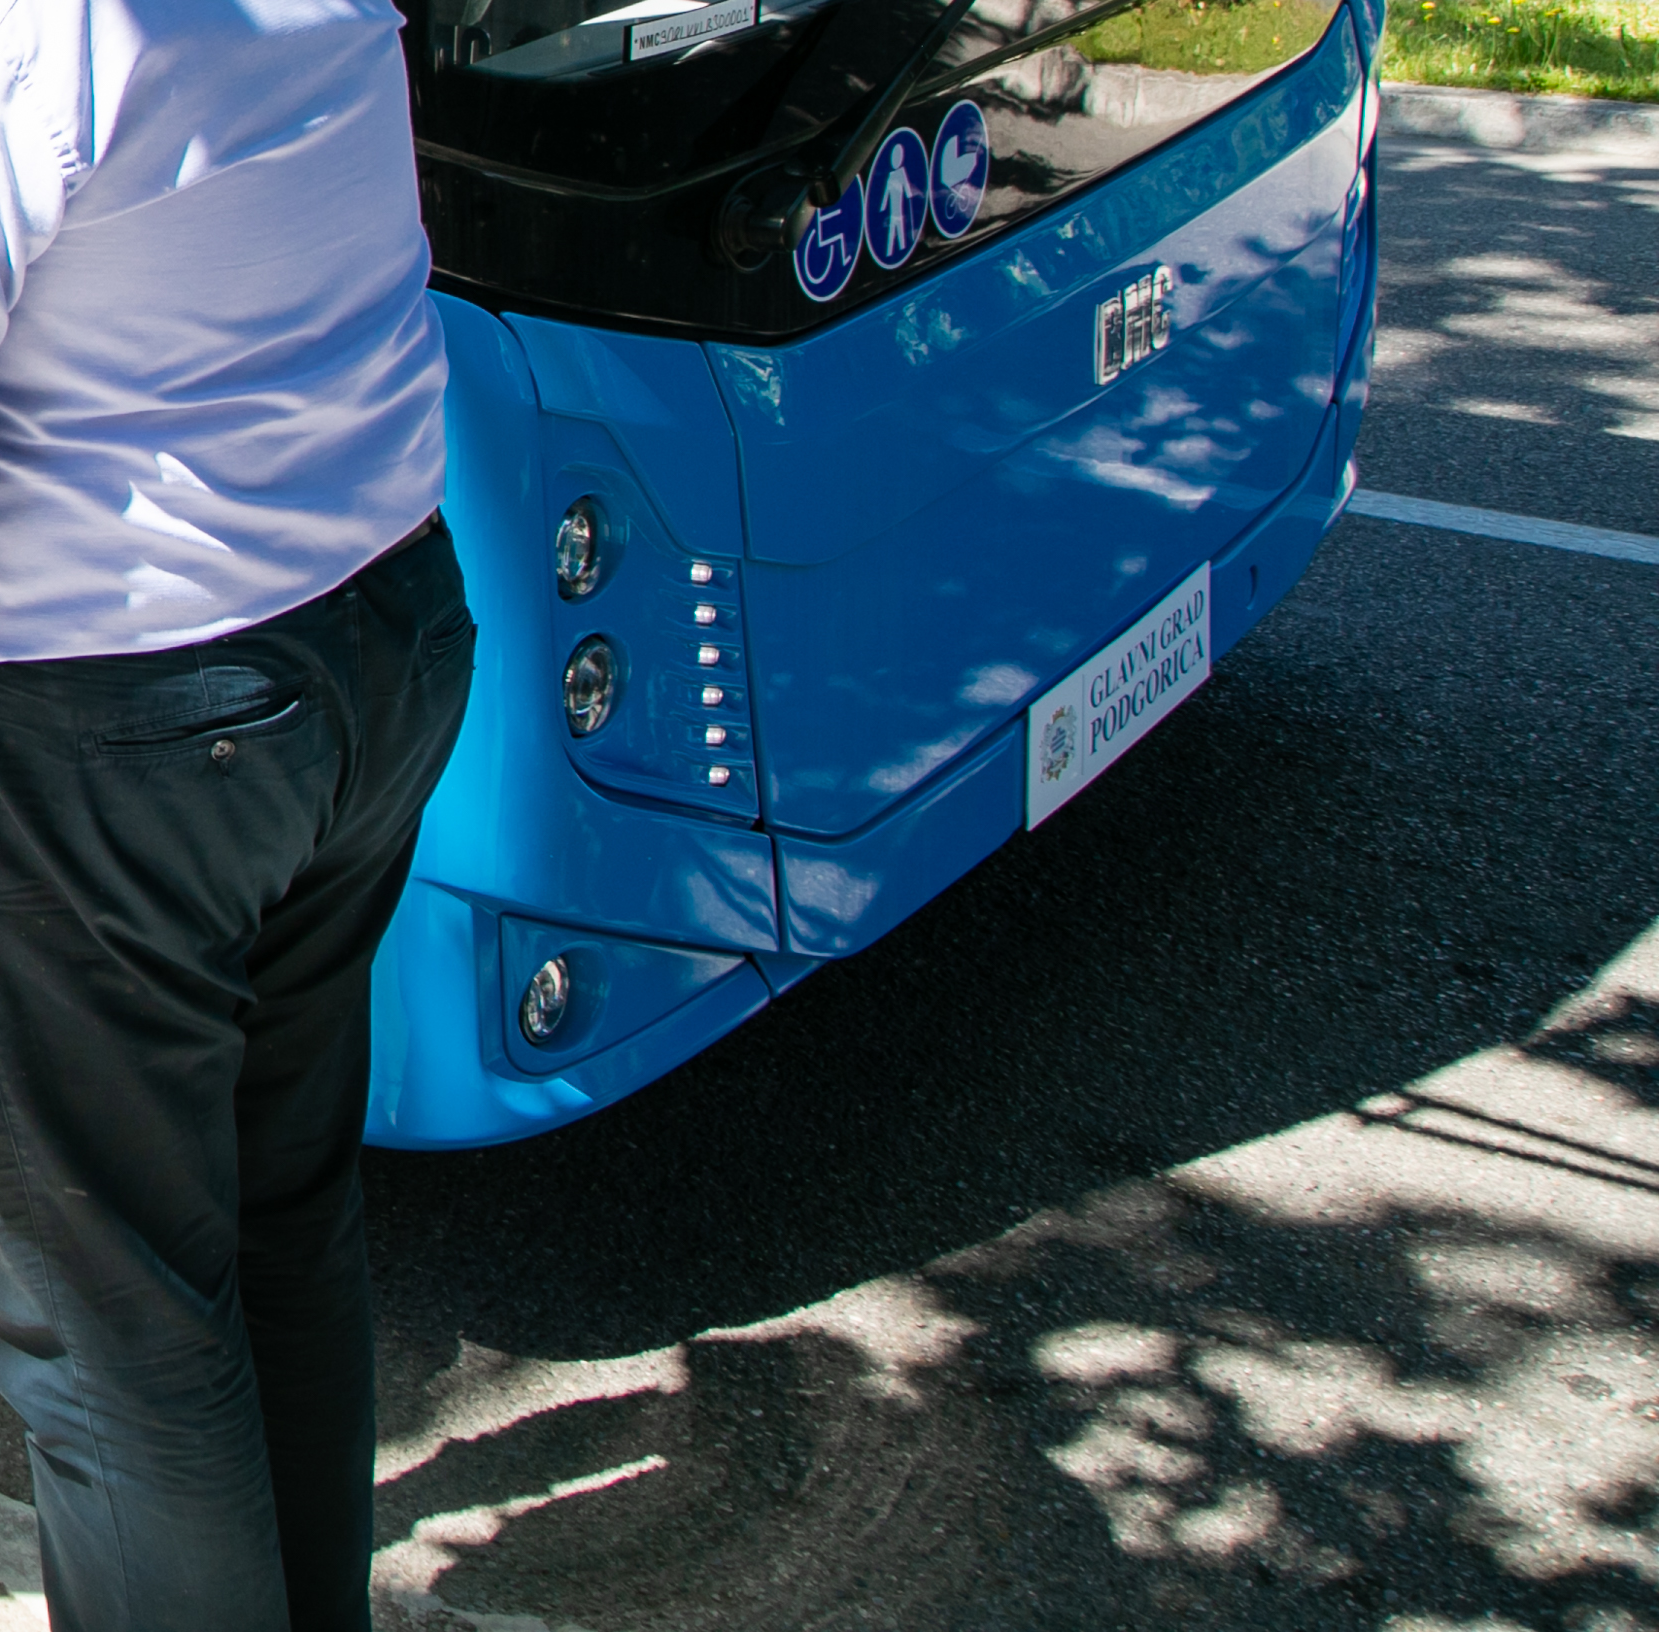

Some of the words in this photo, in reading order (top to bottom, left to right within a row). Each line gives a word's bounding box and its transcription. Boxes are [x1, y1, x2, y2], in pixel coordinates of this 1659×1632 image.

[1089, 629, 1157, 709] GLAVNI
[1159, 589, 1205, 650] GRAD
[1089, 630, 1206, 756] PODGORICA
